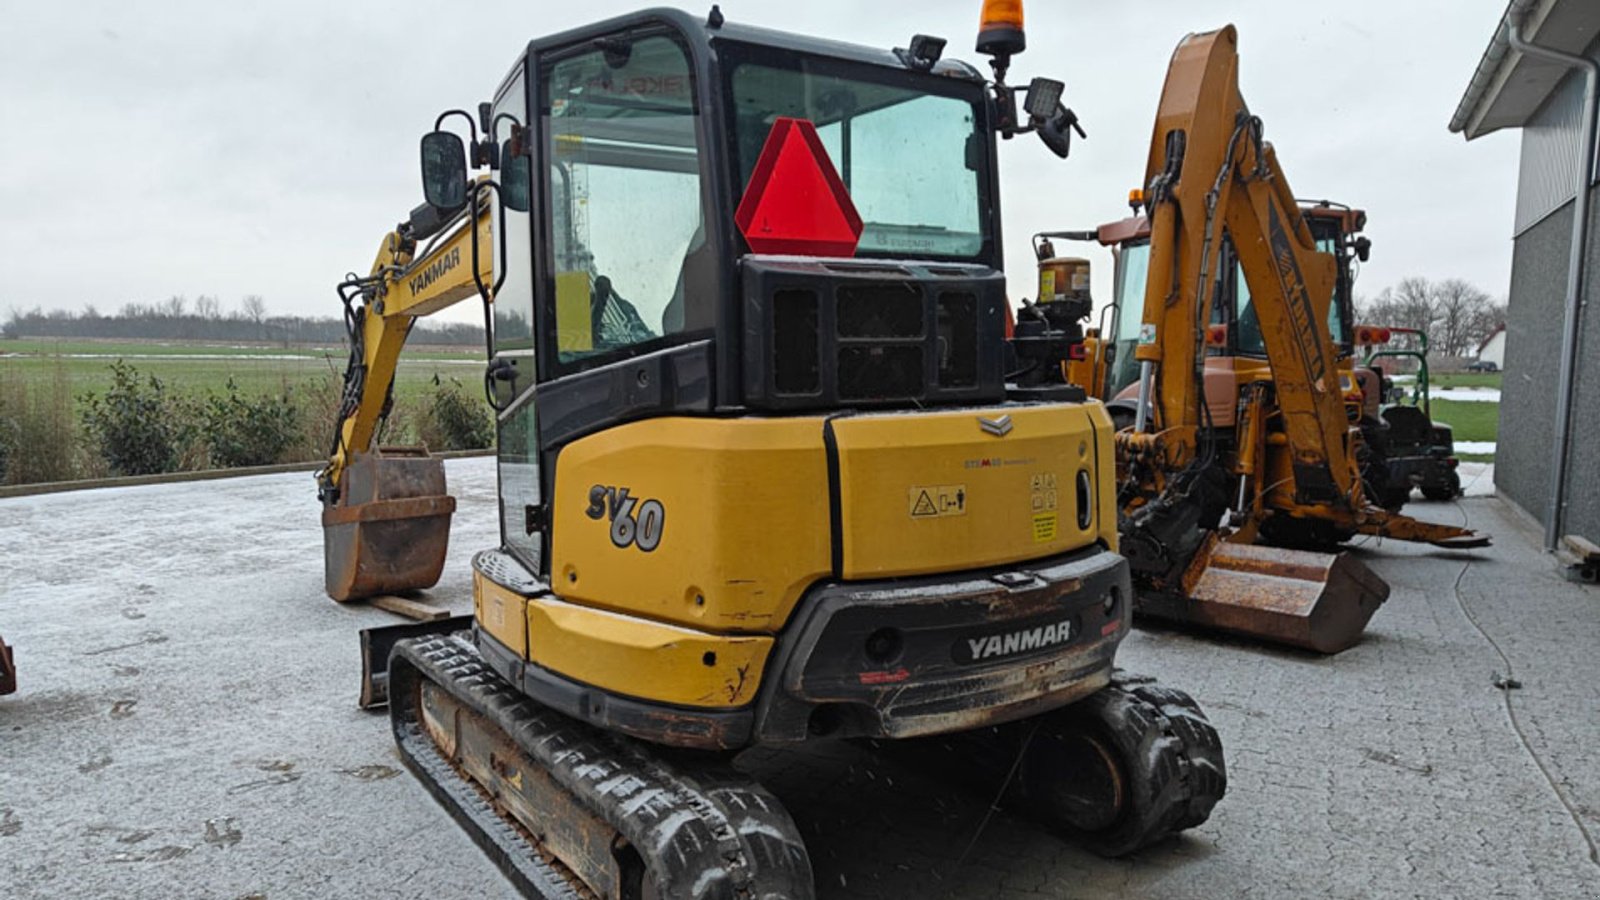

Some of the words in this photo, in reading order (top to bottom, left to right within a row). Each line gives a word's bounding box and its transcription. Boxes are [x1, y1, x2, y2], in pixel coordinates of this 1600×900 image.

[409, 246, 460, 297] YANMAR
[585, 484, 665, 553] SV60
[968, 620, 1071, 660] YANMAR
